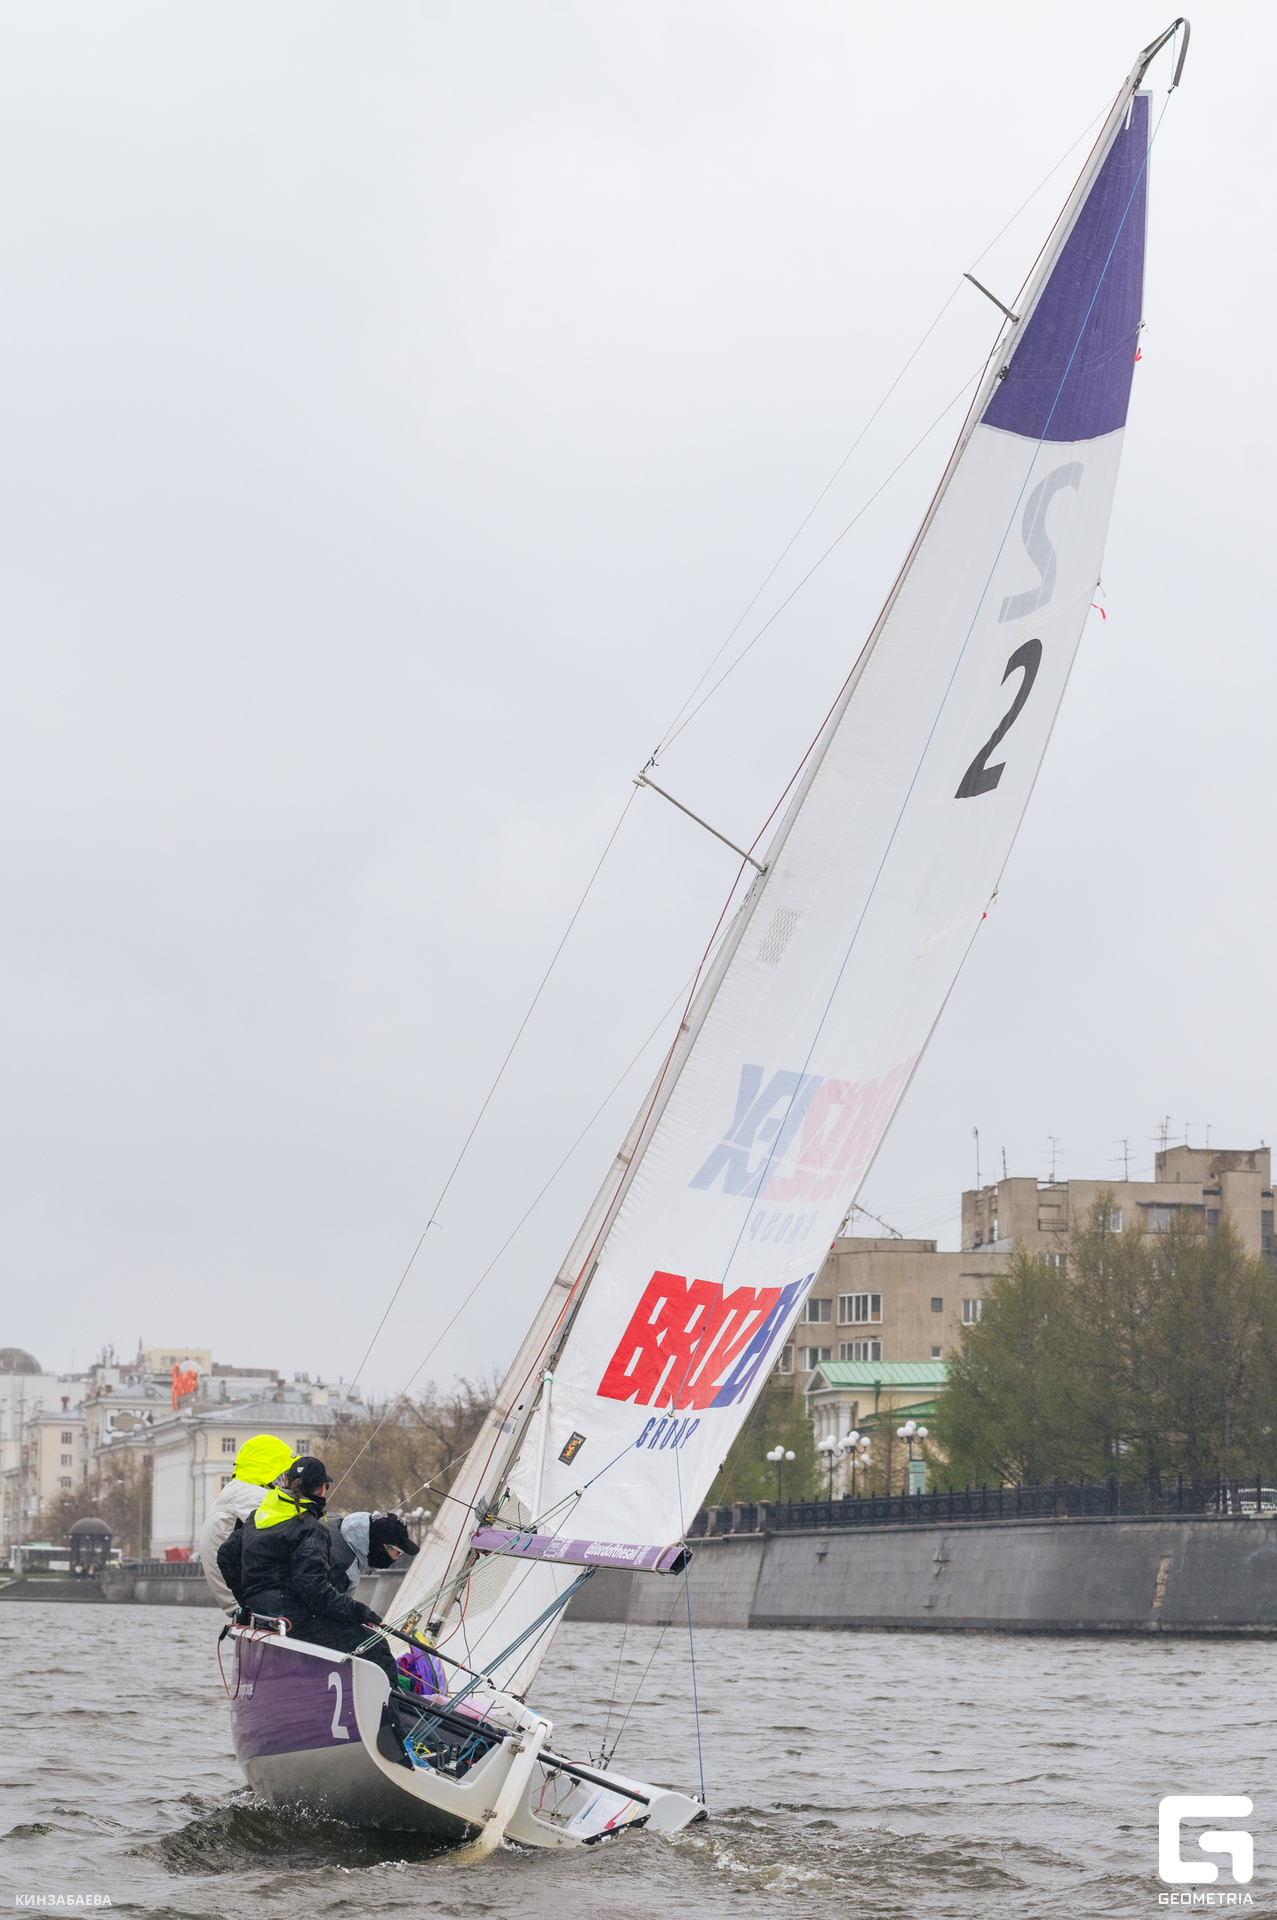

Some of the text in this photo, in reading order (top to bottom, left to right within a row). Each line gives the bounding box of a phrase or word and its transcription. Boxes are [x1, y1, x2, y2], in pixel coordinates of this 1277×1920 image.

[954, 638, 1043, 799] 2
[635, 1416, 701, 1451] GROUP
[328, 1671, 350, 1739] 2
